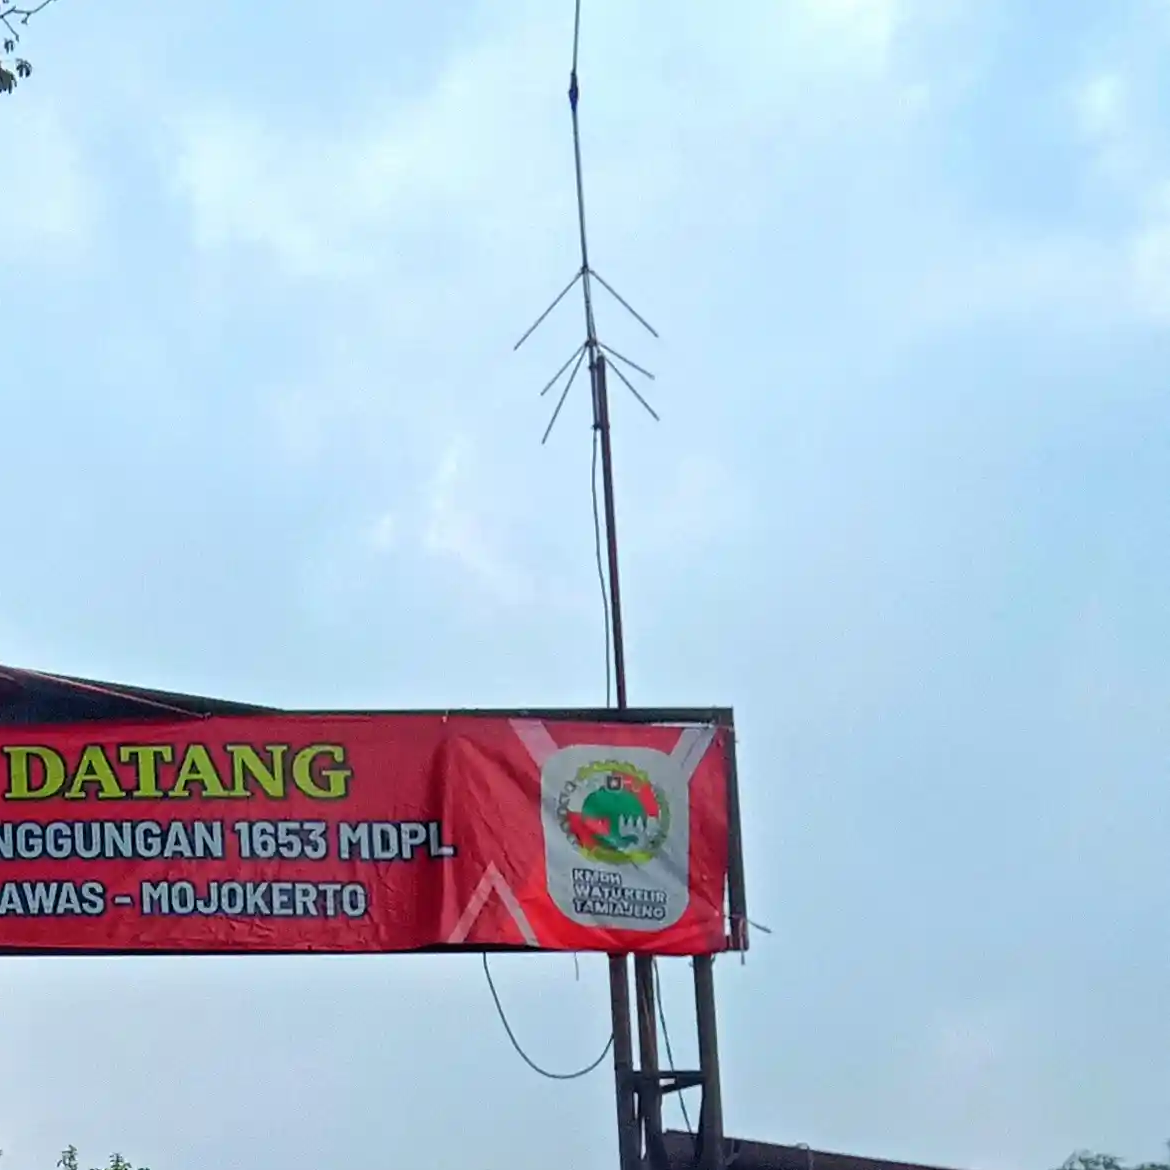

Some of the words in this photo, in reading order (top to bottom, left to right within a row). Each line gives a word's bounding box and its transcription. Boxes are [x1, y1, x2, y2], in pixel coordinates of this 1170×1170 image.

[3, 744, 352, 799] DATANG
[234, 820, 327, 858] 1653
[338, 820, 455, 860] MDPL
[141, 880, 367, 917] MOJOKERTO
